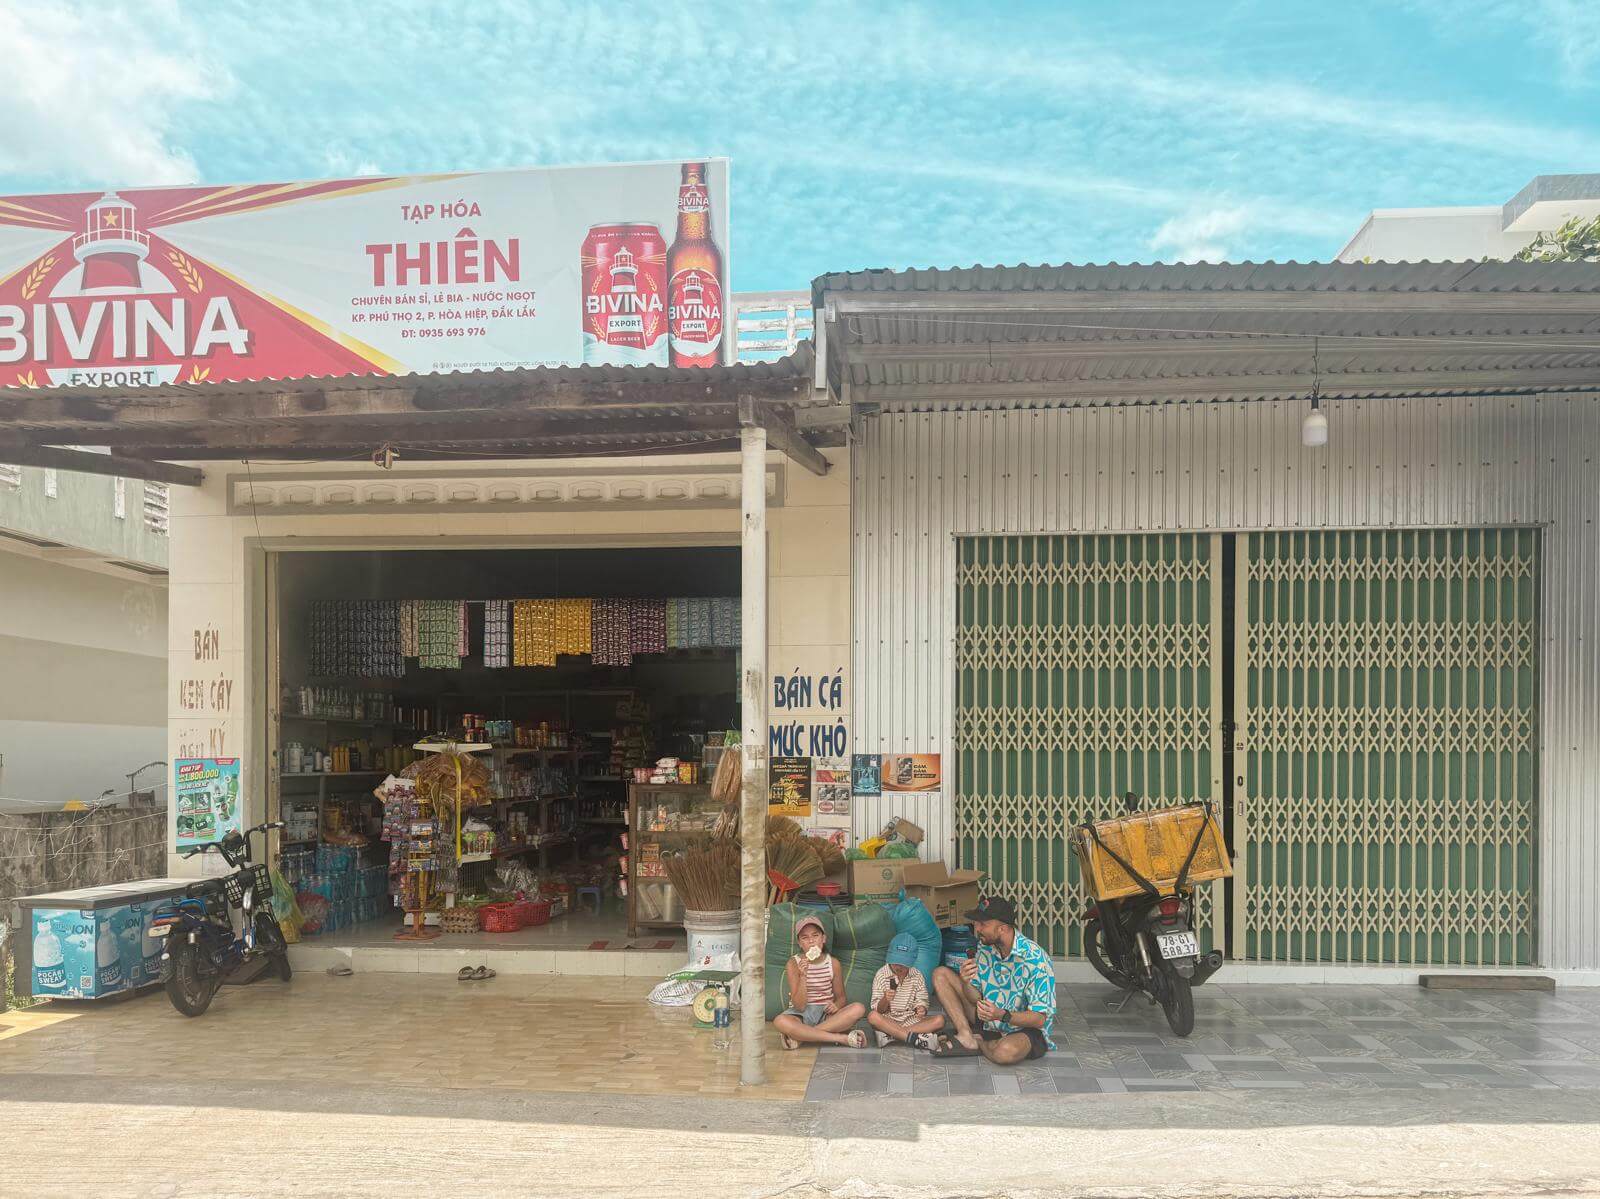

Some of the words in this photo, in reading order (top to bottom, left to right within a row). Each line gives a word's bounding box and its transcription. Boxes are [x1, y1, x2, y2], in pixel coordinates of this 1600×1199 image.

[401, 205, 435, 224] TẠP
[440, 199, 482, 219] HÓA
[365, 227, 520, 287] THIÊN
[351, 294, 392, 306] CHUYÊN
[395, 293, 416, 305] BÁN
[447, 294, 464, 303] BIA
[472, 290, 503, 302] NƯỚC
[506, 291, 536, 303] NGỌT
[586, 293, 663, 314] BIVINA
[352, 313, 366, 323] KP.
[369, 310, 389, 322] PHÚ
[392, 312, 412, 324] THỌ
[415, 311, 425, 322] 2,
[428, 311, 436, 320] P.
[439, 308, 462, 320] HÒA
[669, 305, 721, 320] BIVINA
[0, 296, 249, 363] BIVINA
[401, 329, 416, 338] ĐT:
[419, 329, 443, 338] 0935
[446, 328, 464, 337] 693
[467, 327, 486, 337] 976
[609, 320, 642, 328] EXPORT
[71, 371, 155, 386] EXPORT
[194, 622, 219, 660] BÁN
[211, 672, 233, 712] CÂY
[774, 667, 811, 711] BÁN
[818, 667, 843, 711] CÁ
[809, 717, 847, 758] KHÔ
[37, 969, 65, 978] POCARI
[38, 975, 63, 985] SWEAT
